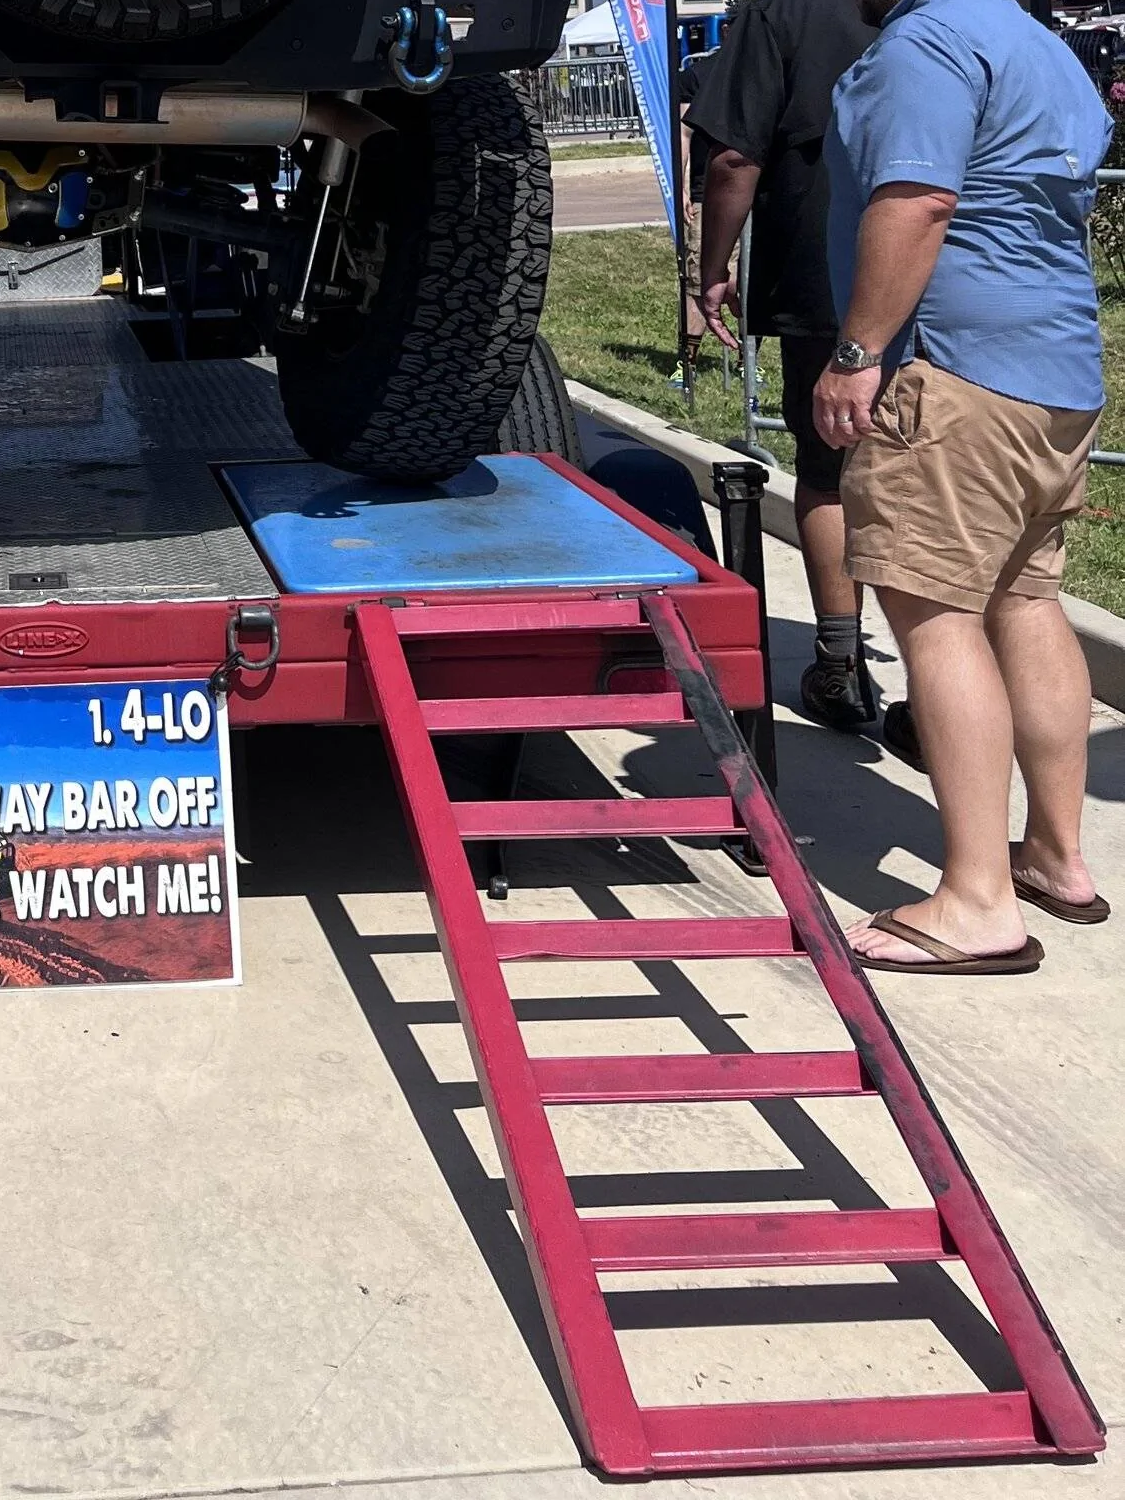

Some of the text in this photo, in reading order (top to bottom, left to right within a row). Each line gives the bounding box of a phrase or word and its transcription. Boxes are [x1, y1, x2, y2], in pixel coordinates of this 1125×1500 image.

[87, 688, 212, 748] 1. 4-LO
[62, 780, 139, 832] BAR
[147, 776, 219, 828] OFF
[9, 864, 146, 921] WATCH
[156, 855, 223, 916] ME!
